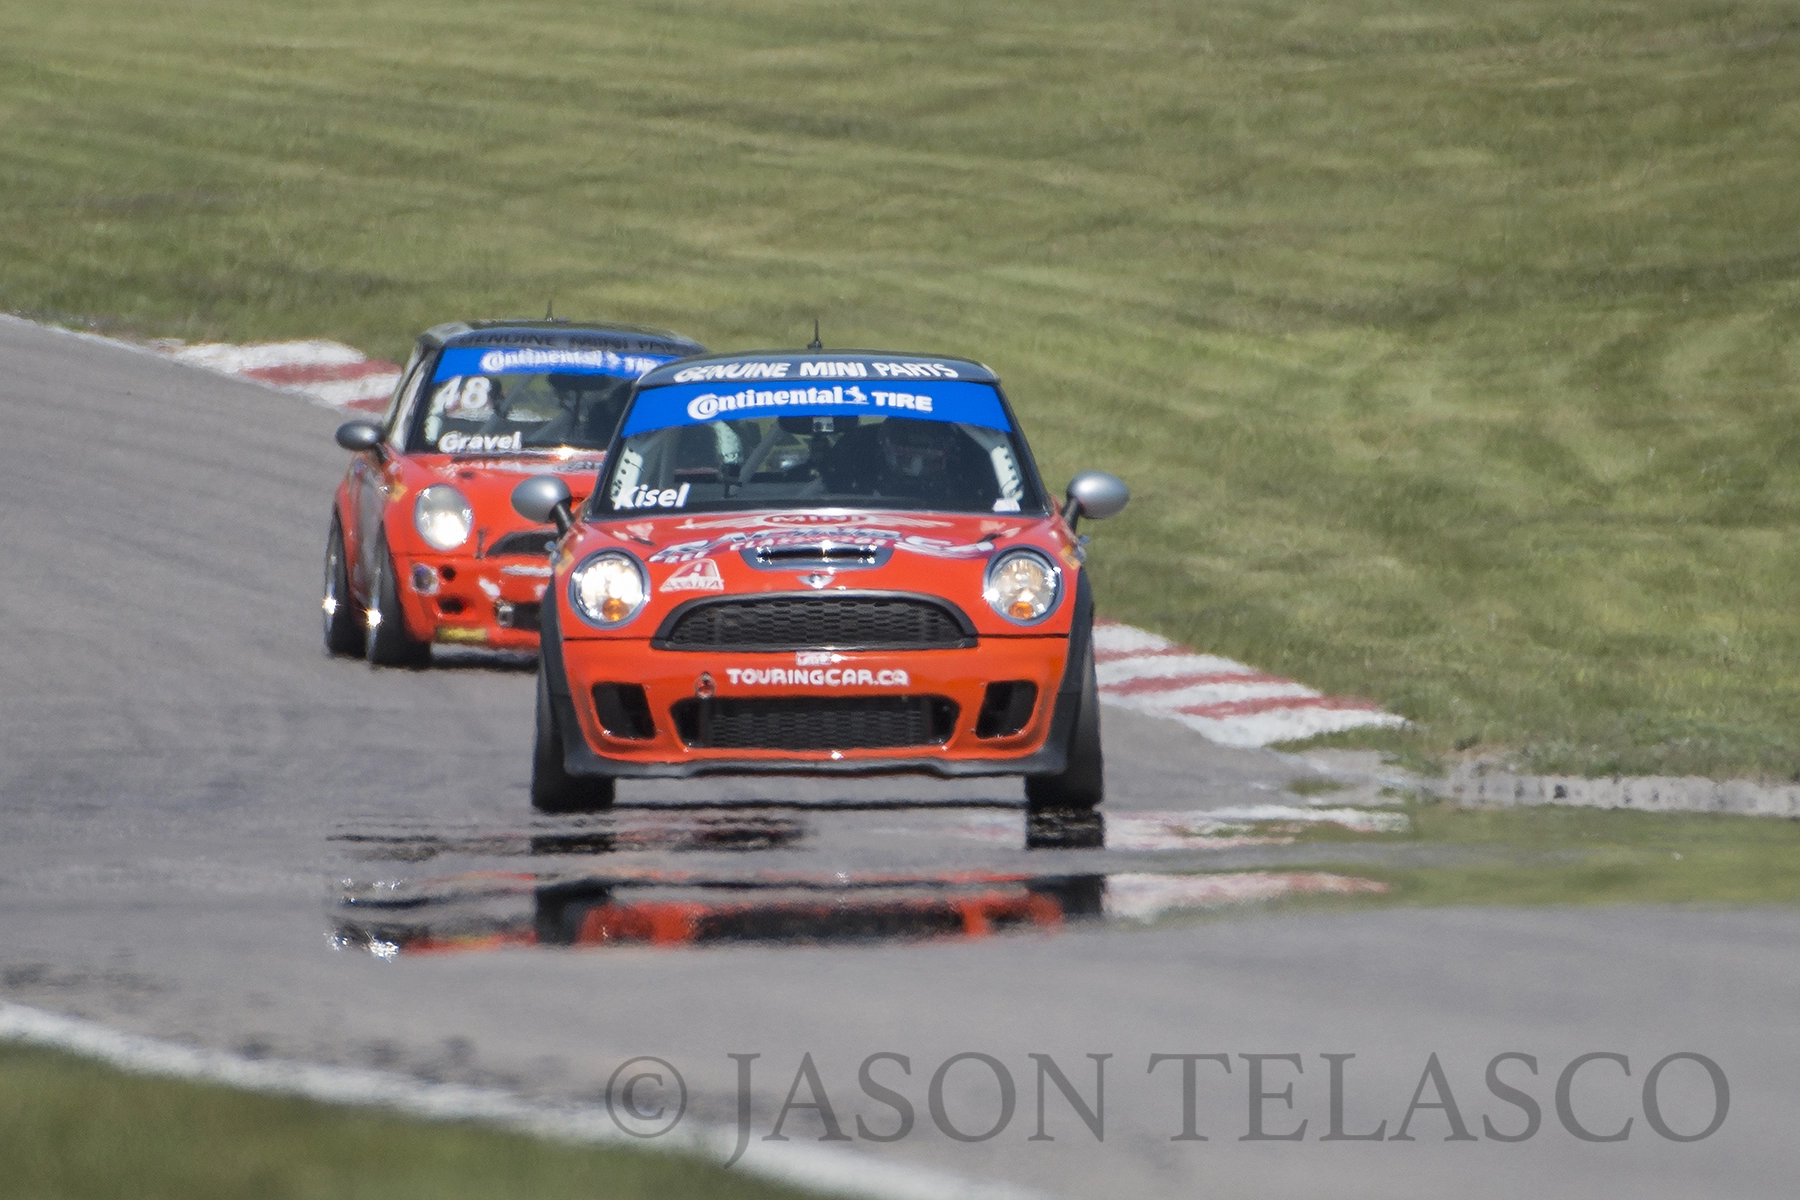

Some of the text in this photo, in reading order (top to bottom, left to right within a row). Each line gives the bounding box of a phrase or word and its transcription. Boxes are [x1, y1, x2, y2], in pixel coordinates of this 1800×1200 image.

[673, 361, 960, 383] GENUINE MINI PARTS
[434, 375, 492, 411] 48
[686, 385, 934, 420] Continental TIRE
[438, 430, 522, 453] Gravel
[612, 482, 691, 511] Kisel
[771, 514, 861, 524] MINI
